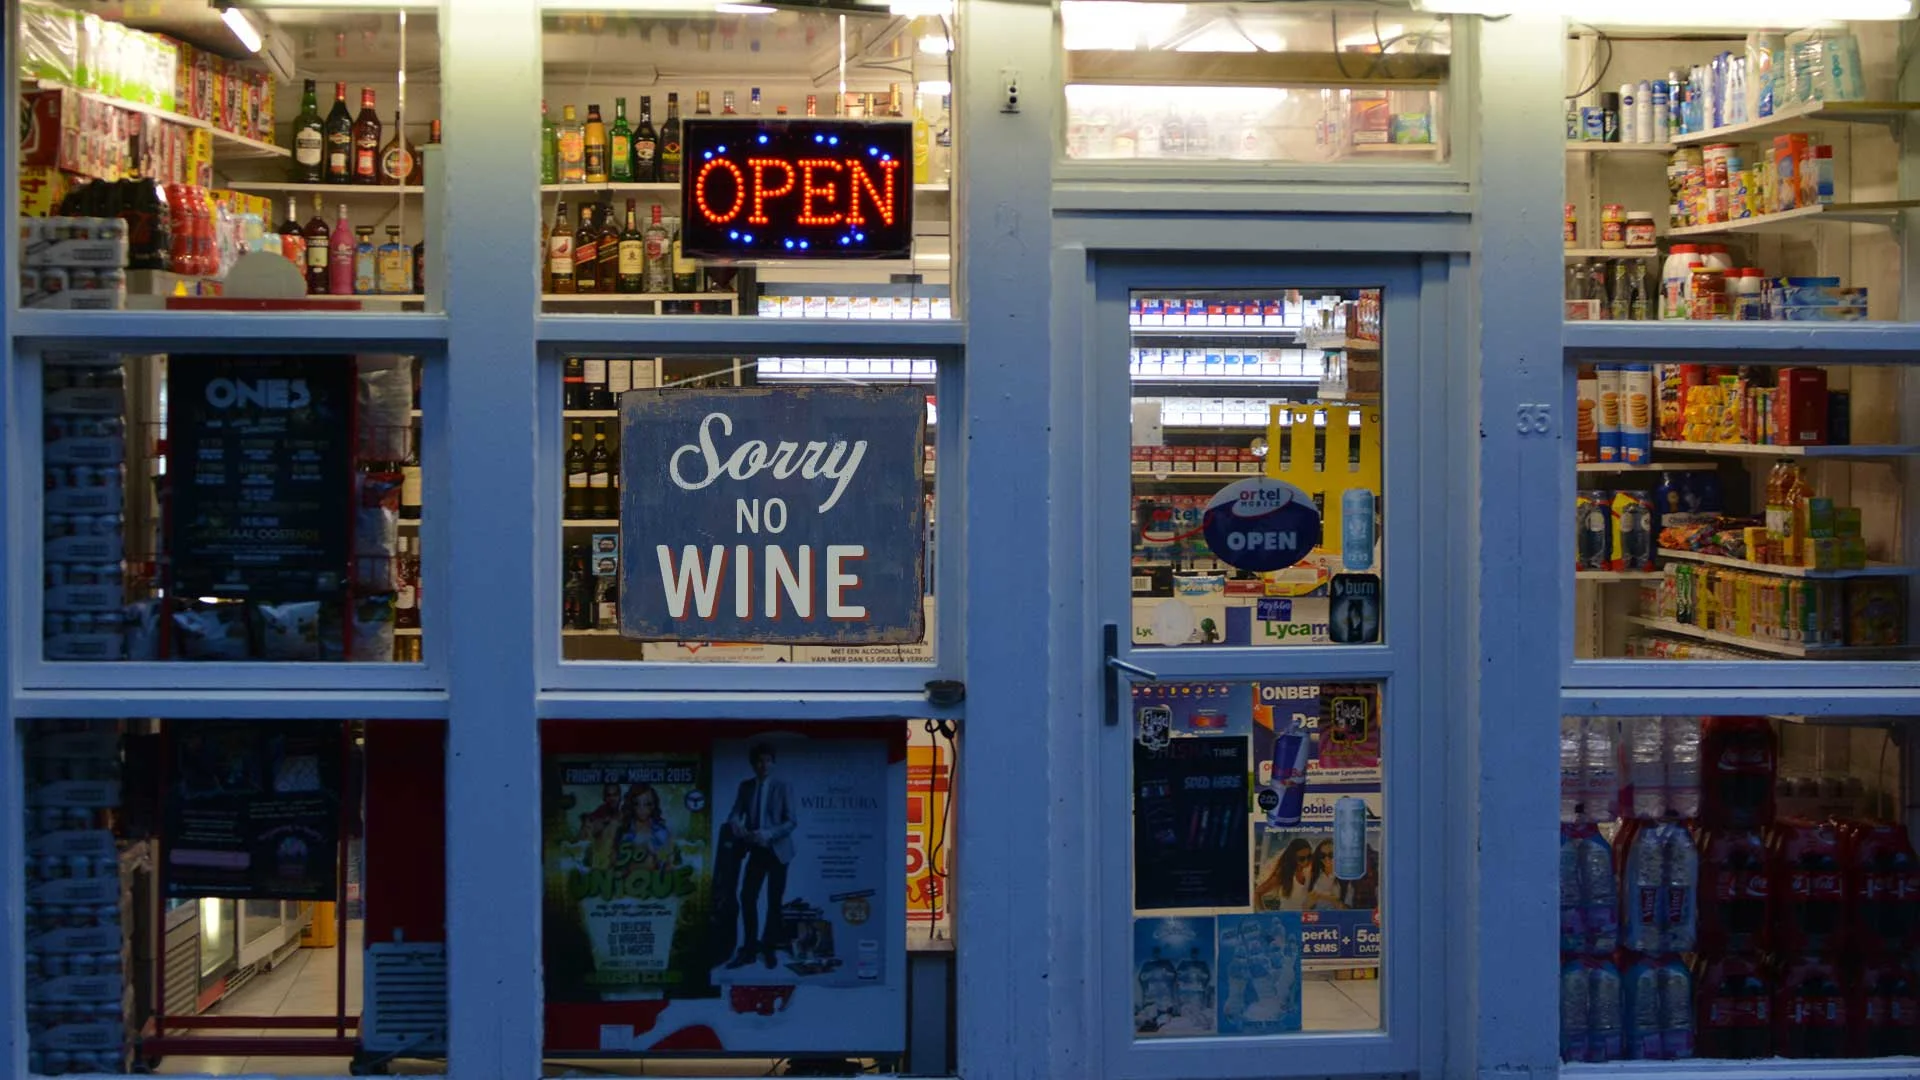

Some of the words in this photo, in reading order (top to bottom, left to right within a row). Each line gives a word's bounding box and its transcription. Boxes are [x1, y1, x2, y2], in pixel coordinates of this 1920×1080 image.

[696, 158, 901, 225] OPEN
[204, 377, 311, 409] ONES
[669, 412, 868, 514] Sorry
[1239, 488, 1281, 500] ortel
[736, 498, 787, 533] NO
[1226, 531, 1297, 550] OPEN
[656, 545, 869, 621] WINE
[1345, 579, 1374, 594] burn
[667, 767, 692, 782] 2015
[1313, 943, 1338, 953] SMS
